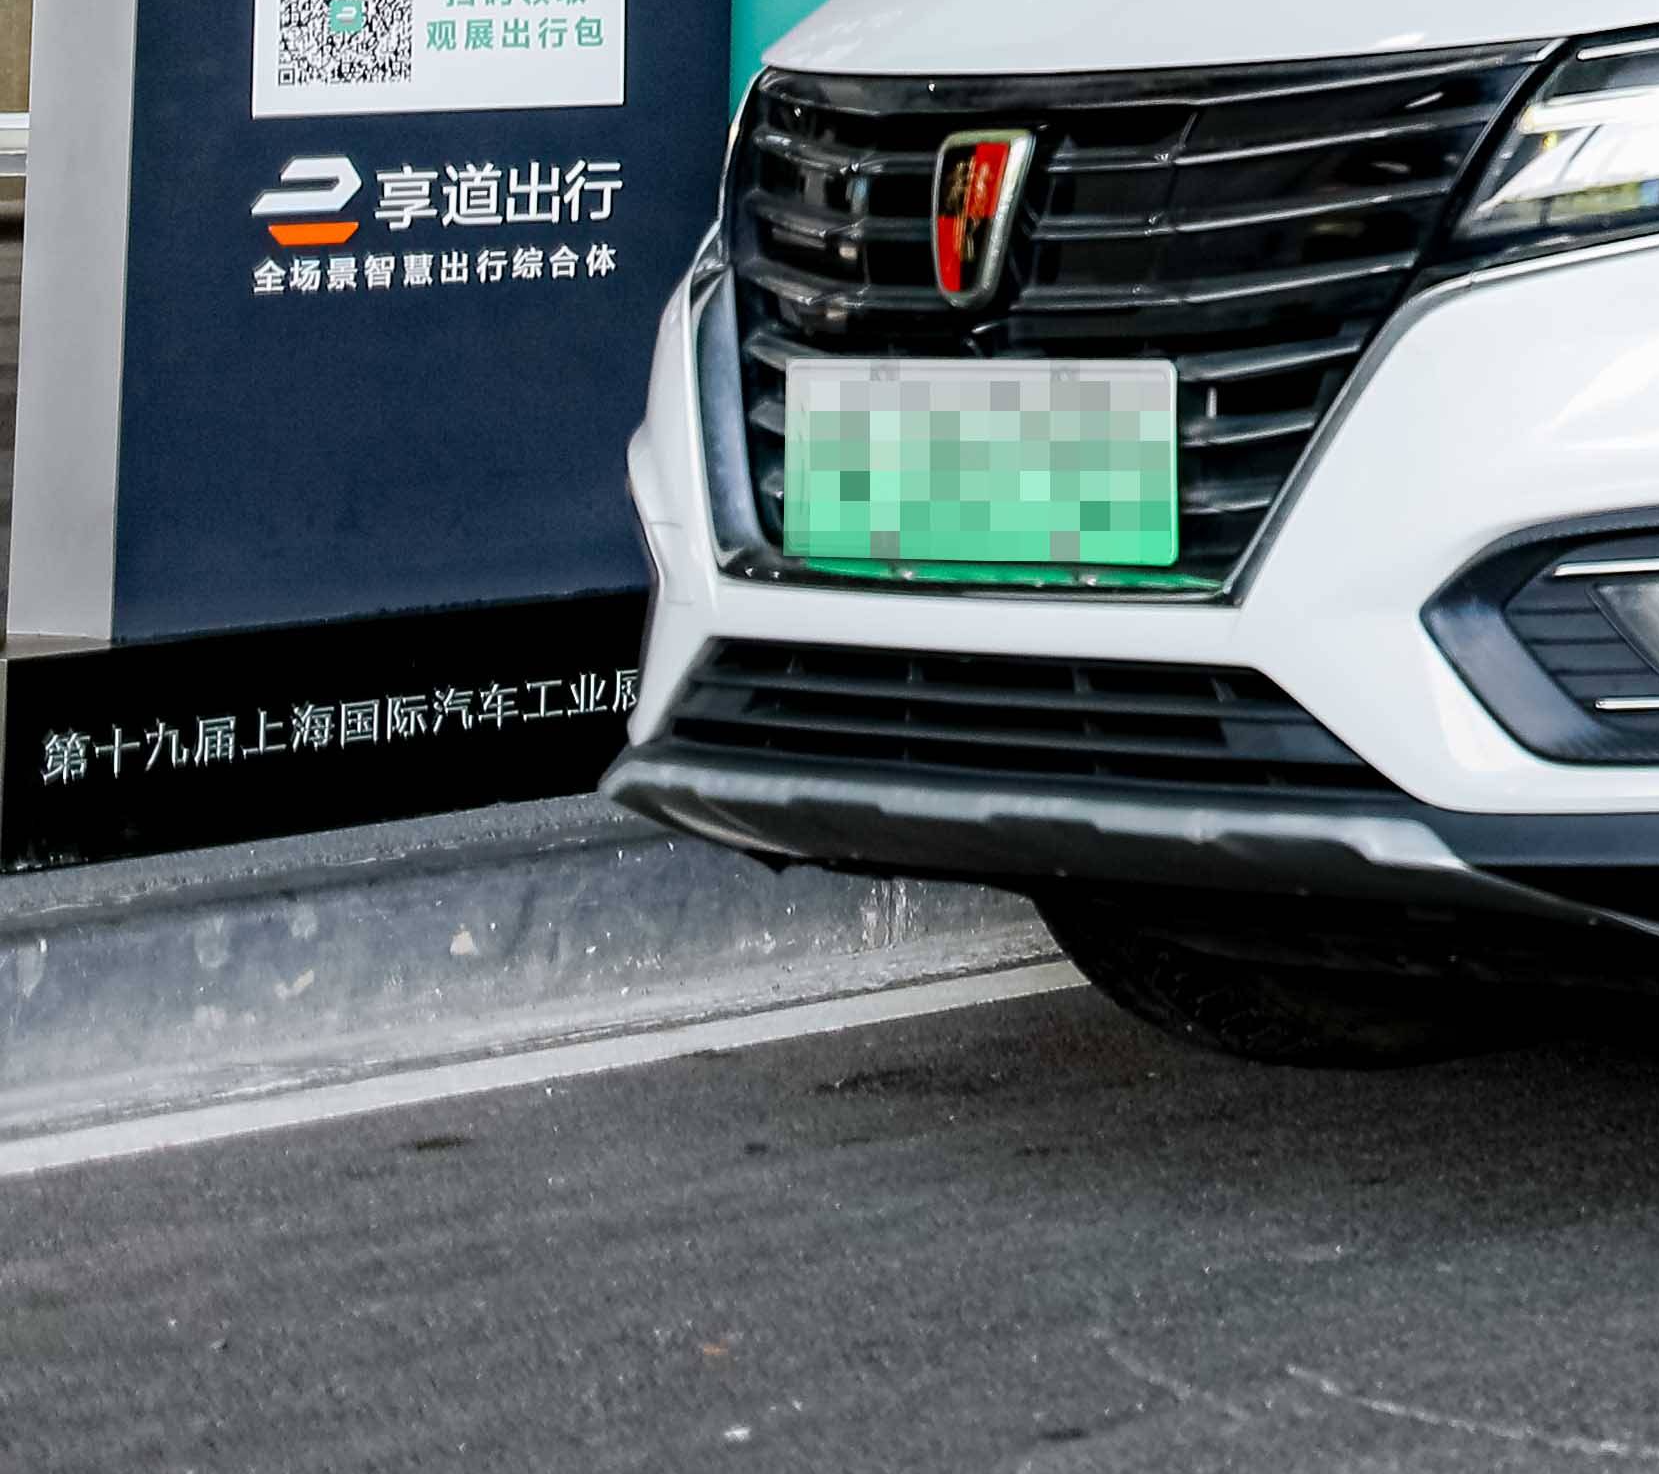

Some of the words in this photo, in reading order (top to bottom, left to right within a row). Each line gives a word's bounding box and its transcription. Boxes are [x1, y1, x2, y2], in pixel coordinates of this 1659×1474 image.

[426, 15, 604, 52] 观展出行包
[374, 159, 623, 230] 享道出行
[253, 243, 617, 294] 全场景智慧出行综合体
